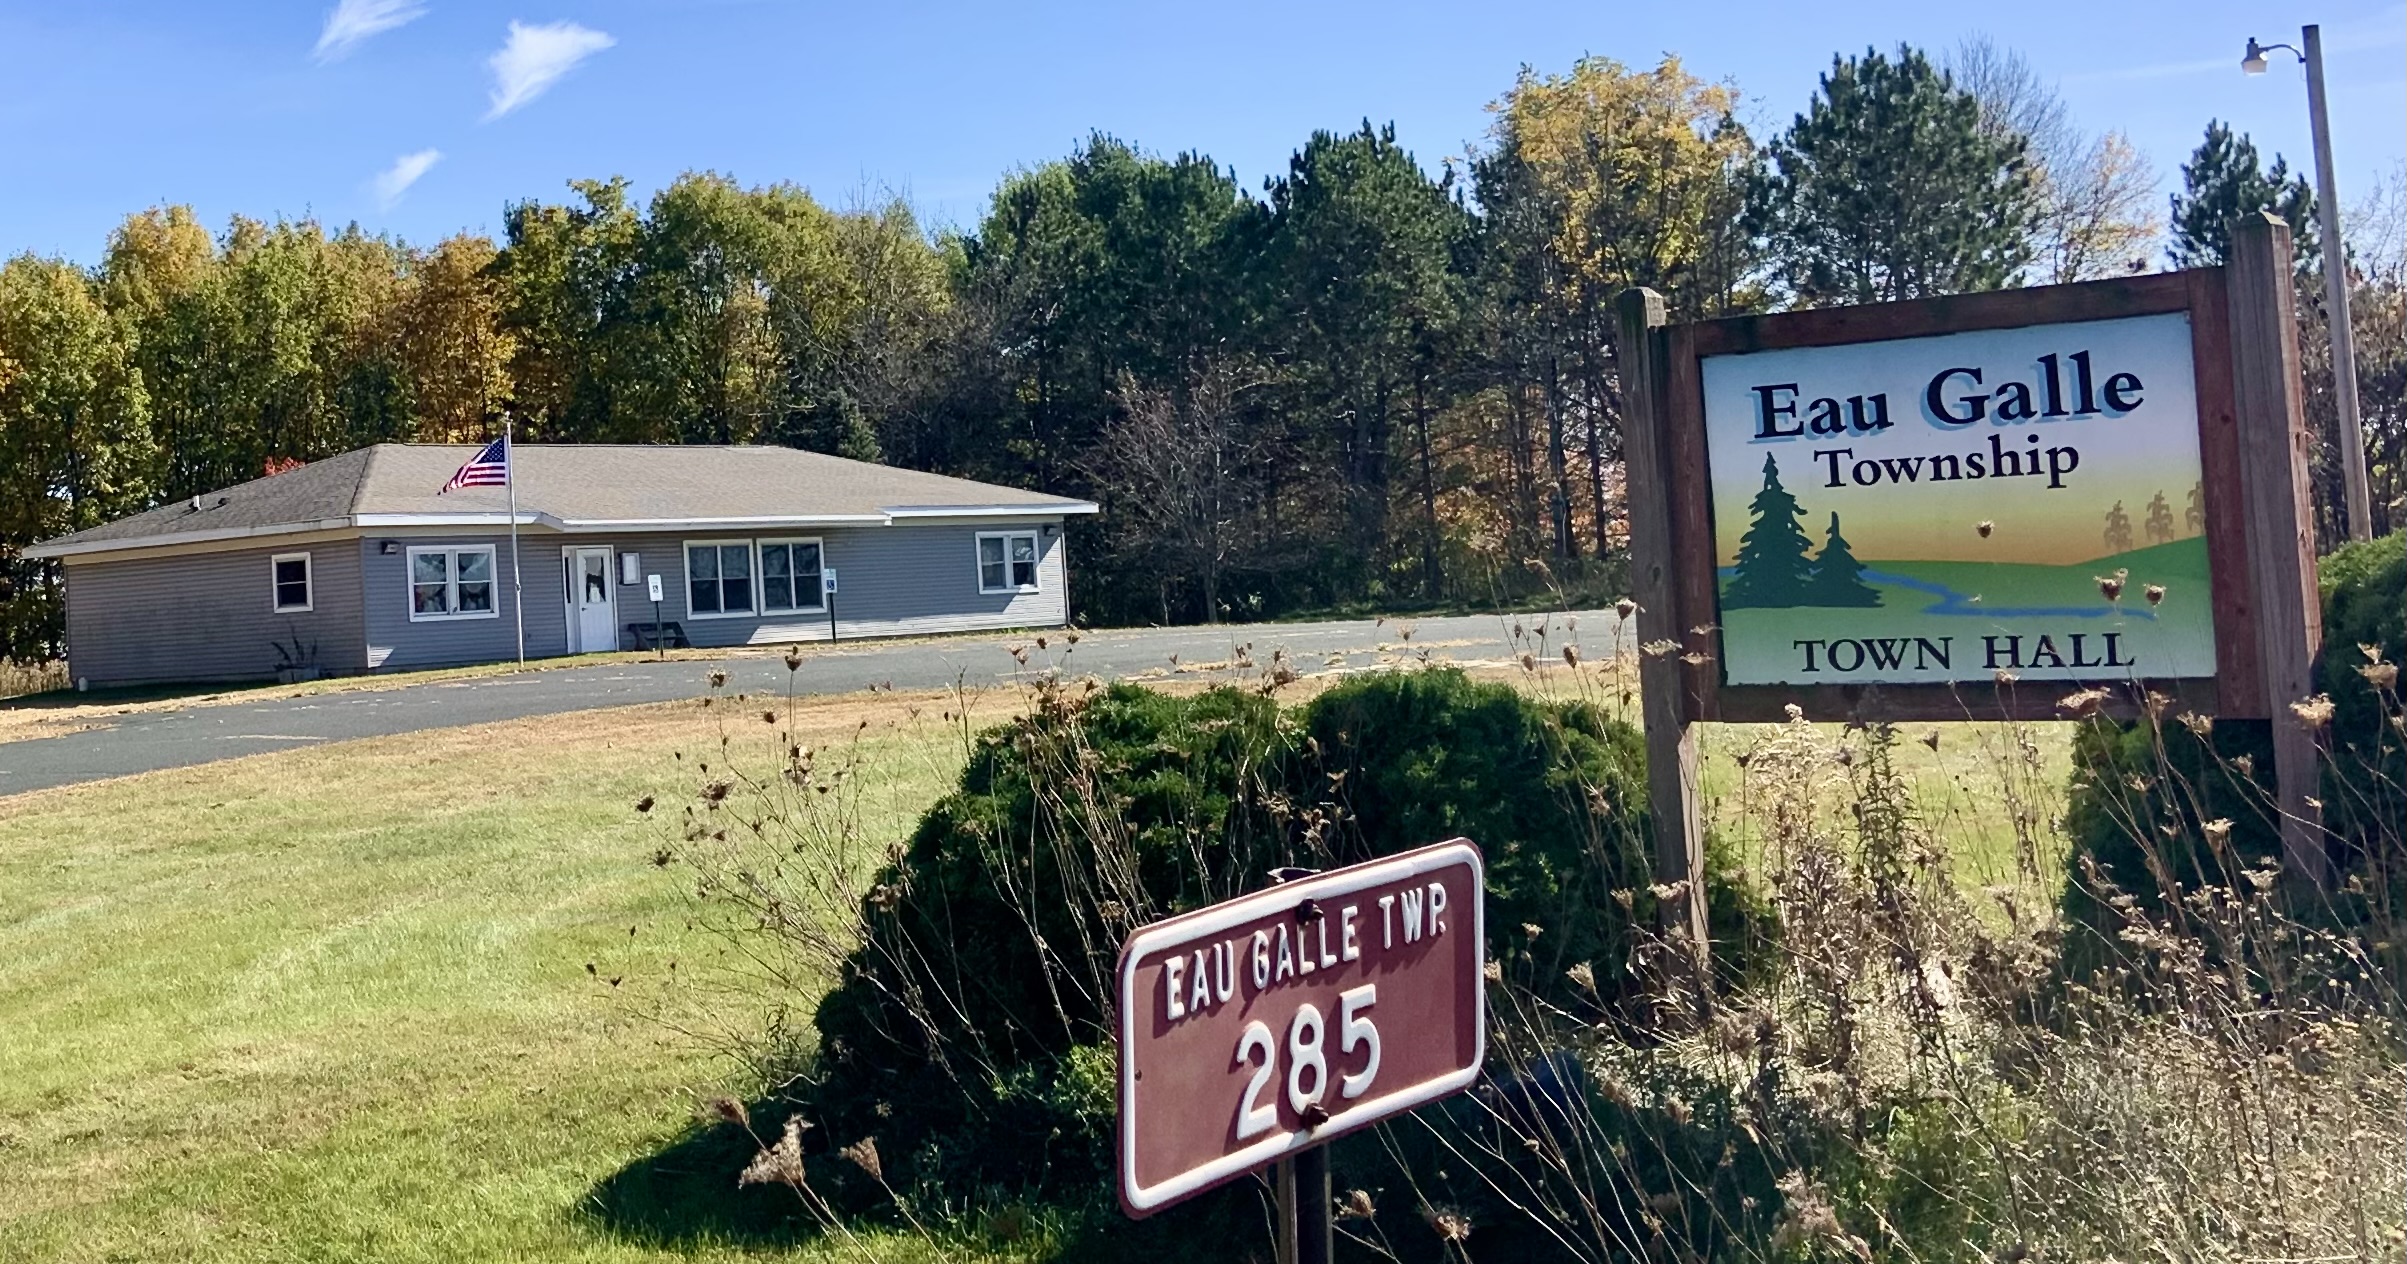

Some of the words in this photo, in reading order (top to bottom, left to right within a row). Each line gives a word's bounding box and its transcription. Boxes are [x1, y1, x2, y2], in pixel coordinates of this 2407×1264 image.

[1751, 381, 1894, 440] Eau
[1925, 350, 2145, 427] Galle
[1814, 433, 2080, 489] Township
[1793, 637, 1954, 673] TOWN
[1982, 632, 2136, 670] HALL
[1165, 940, 1235, 1021] EAU
[1252, 905, 1360, 990] GALLE
[1378, 882, 1447, 949] TWP.
[1236, 983, 1381, 1141] 285
